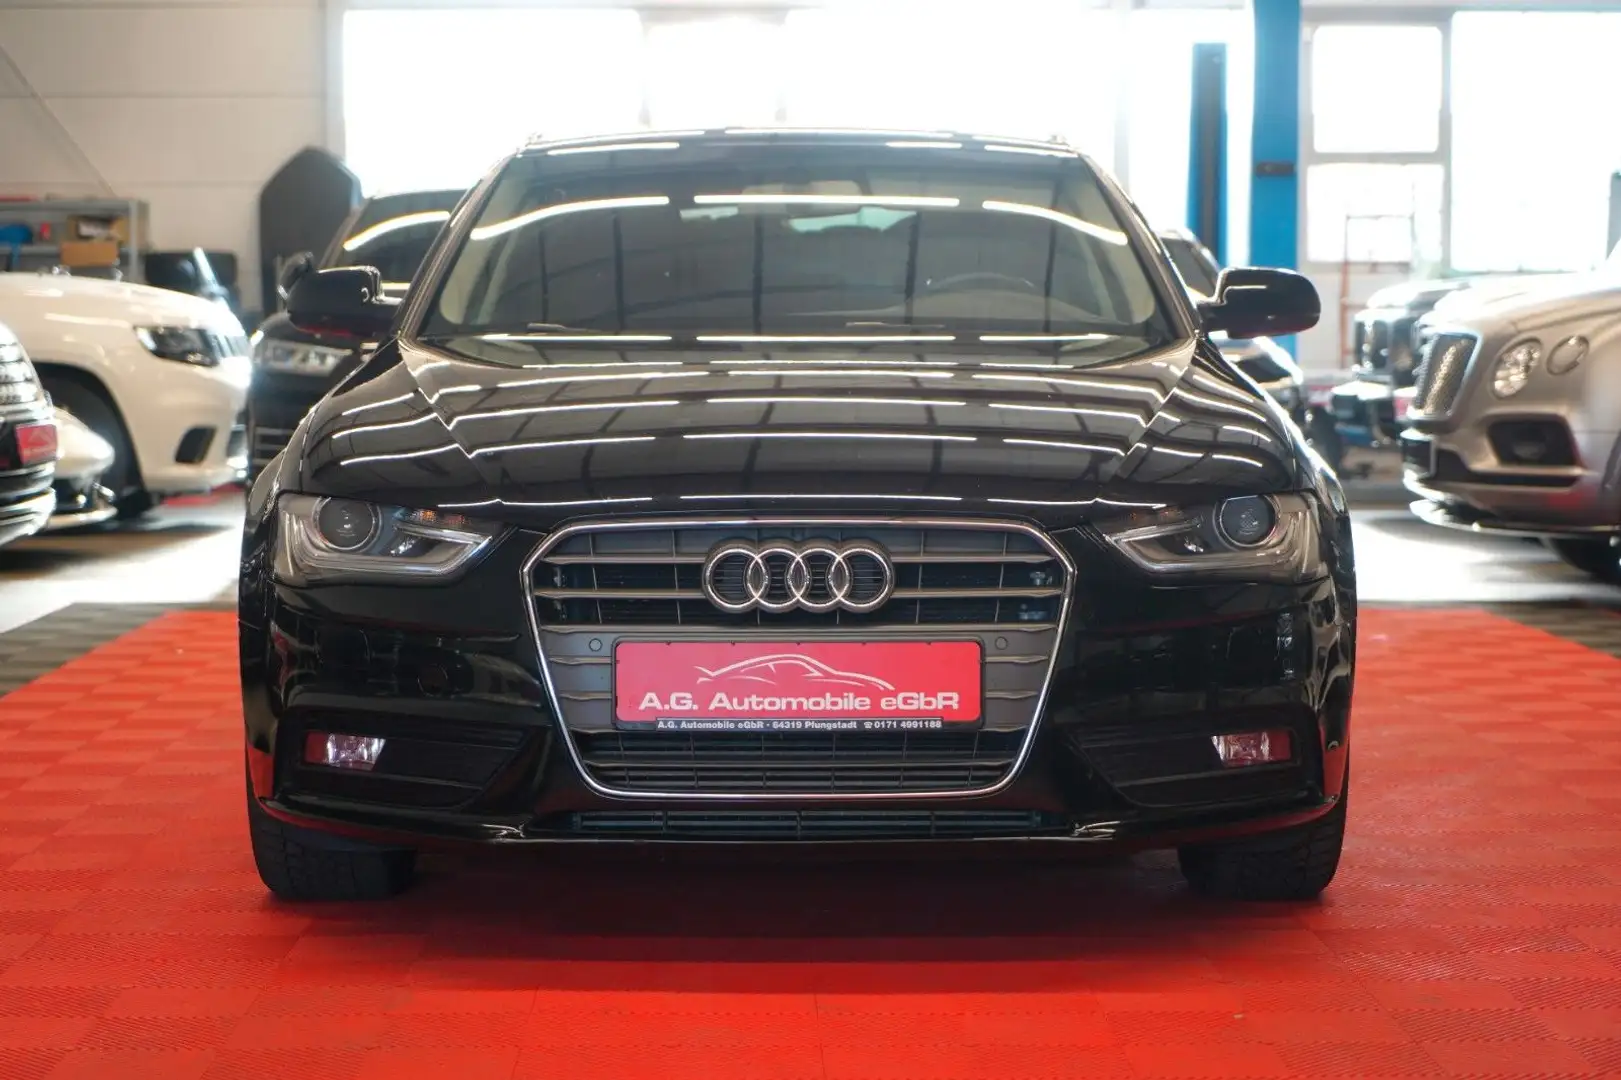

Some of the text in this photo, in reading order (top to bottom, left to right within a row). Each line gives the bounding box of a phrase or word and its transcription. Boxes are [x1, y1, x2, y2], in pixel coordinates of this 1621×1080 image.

[638, 692, 959, 711] A.G. Automobile eGbR
[657, 721, 678, 729] A.G.
[680, 721, 735, 730] Automobile
[737, 721, 764, 729] eGbR
[874, 720, 897, 729] 0171
